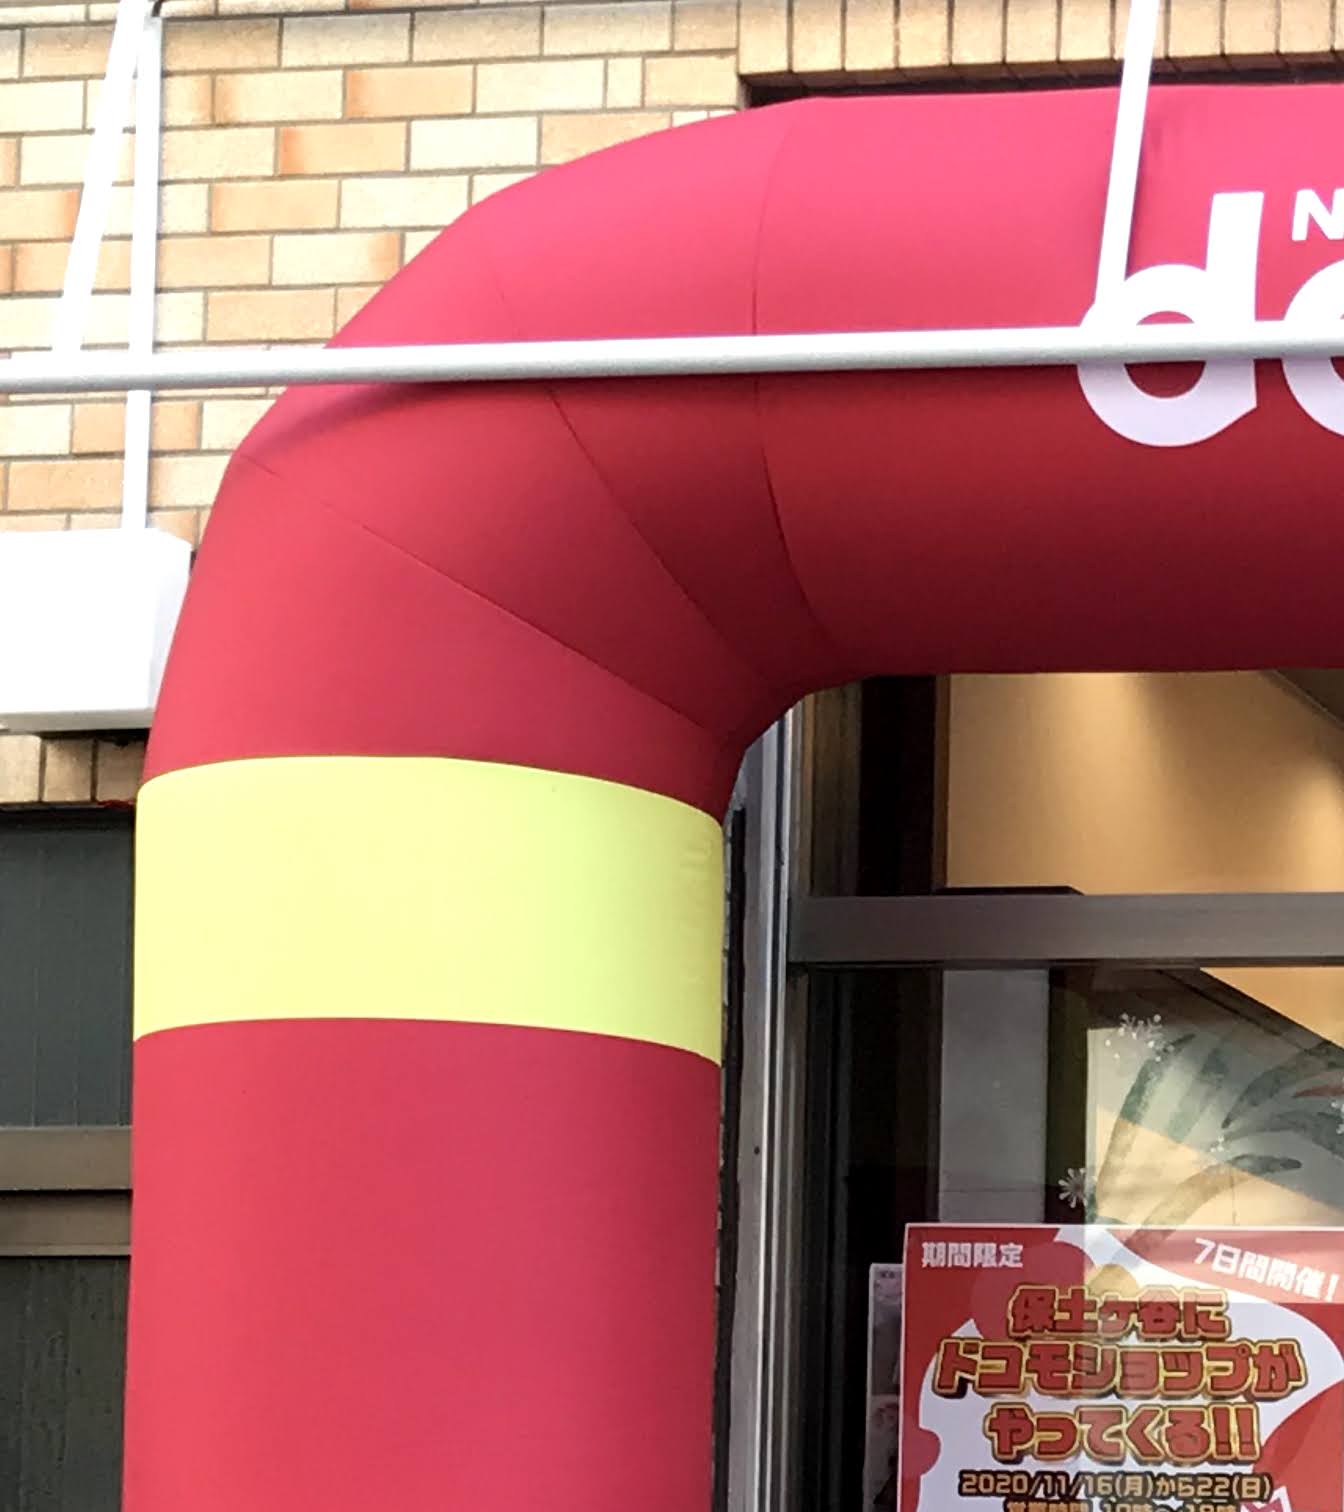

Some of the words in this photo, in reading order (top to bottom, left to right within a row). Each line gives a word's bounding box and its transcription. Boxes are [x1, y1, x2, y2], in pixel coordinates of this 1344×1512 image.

[920, 1240, 1024, 1270] 期間限定
[933, 1338, 1307, 1398] ドコモショップが
[959, 1471, 1274, 1500] 2020/11/16(月)から22(日)
